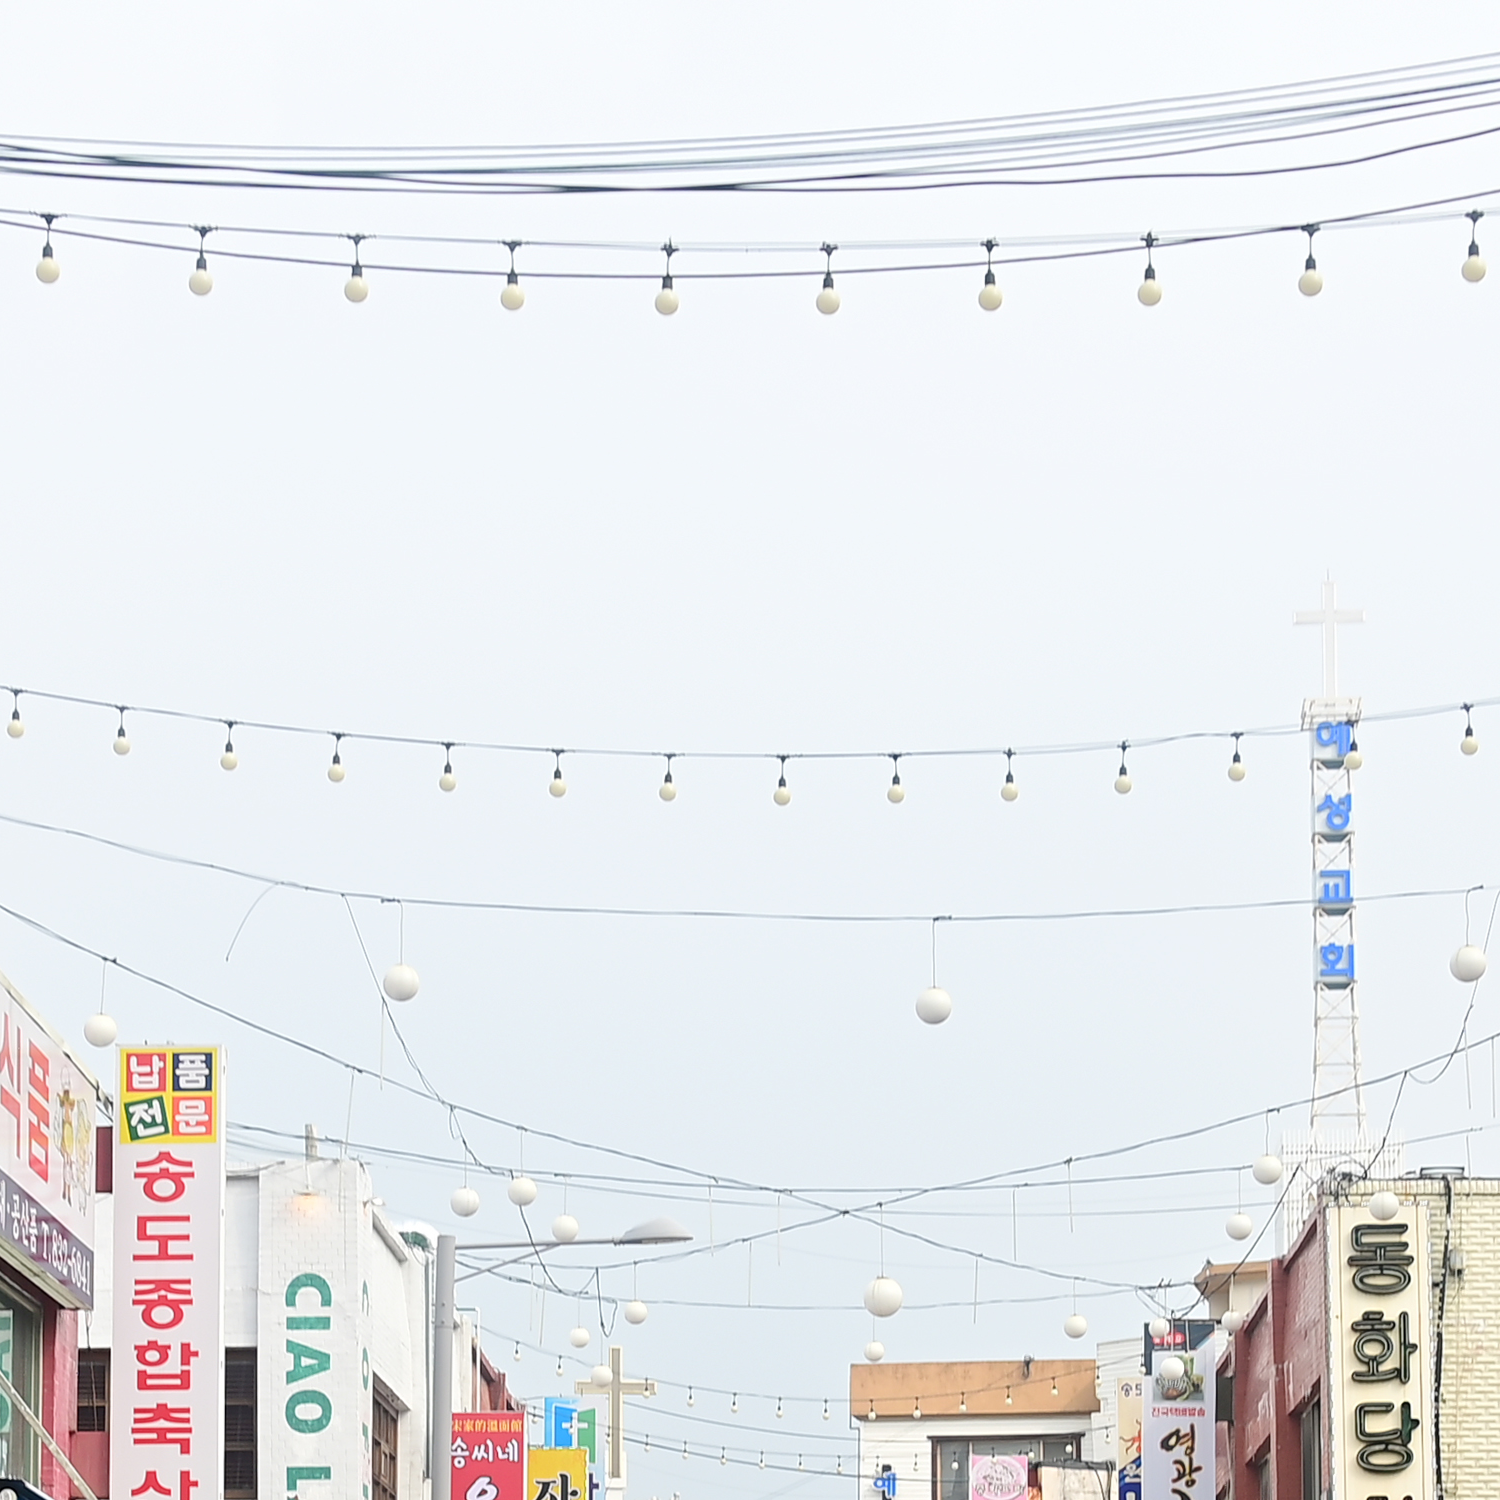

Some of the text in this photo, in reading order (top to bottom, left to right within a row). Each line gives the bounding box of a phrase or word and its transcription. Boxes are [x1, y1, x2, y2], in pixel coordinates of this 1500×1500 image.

[1315, 720, 1356, 981] 예성교회
[127, 1052, 212, 1092] 납품
[125, 1096, 213, 1139] 전문
[284, 1273, 334, 1434] CIAO
[449, 1436, 520, 1470] 송씨네
